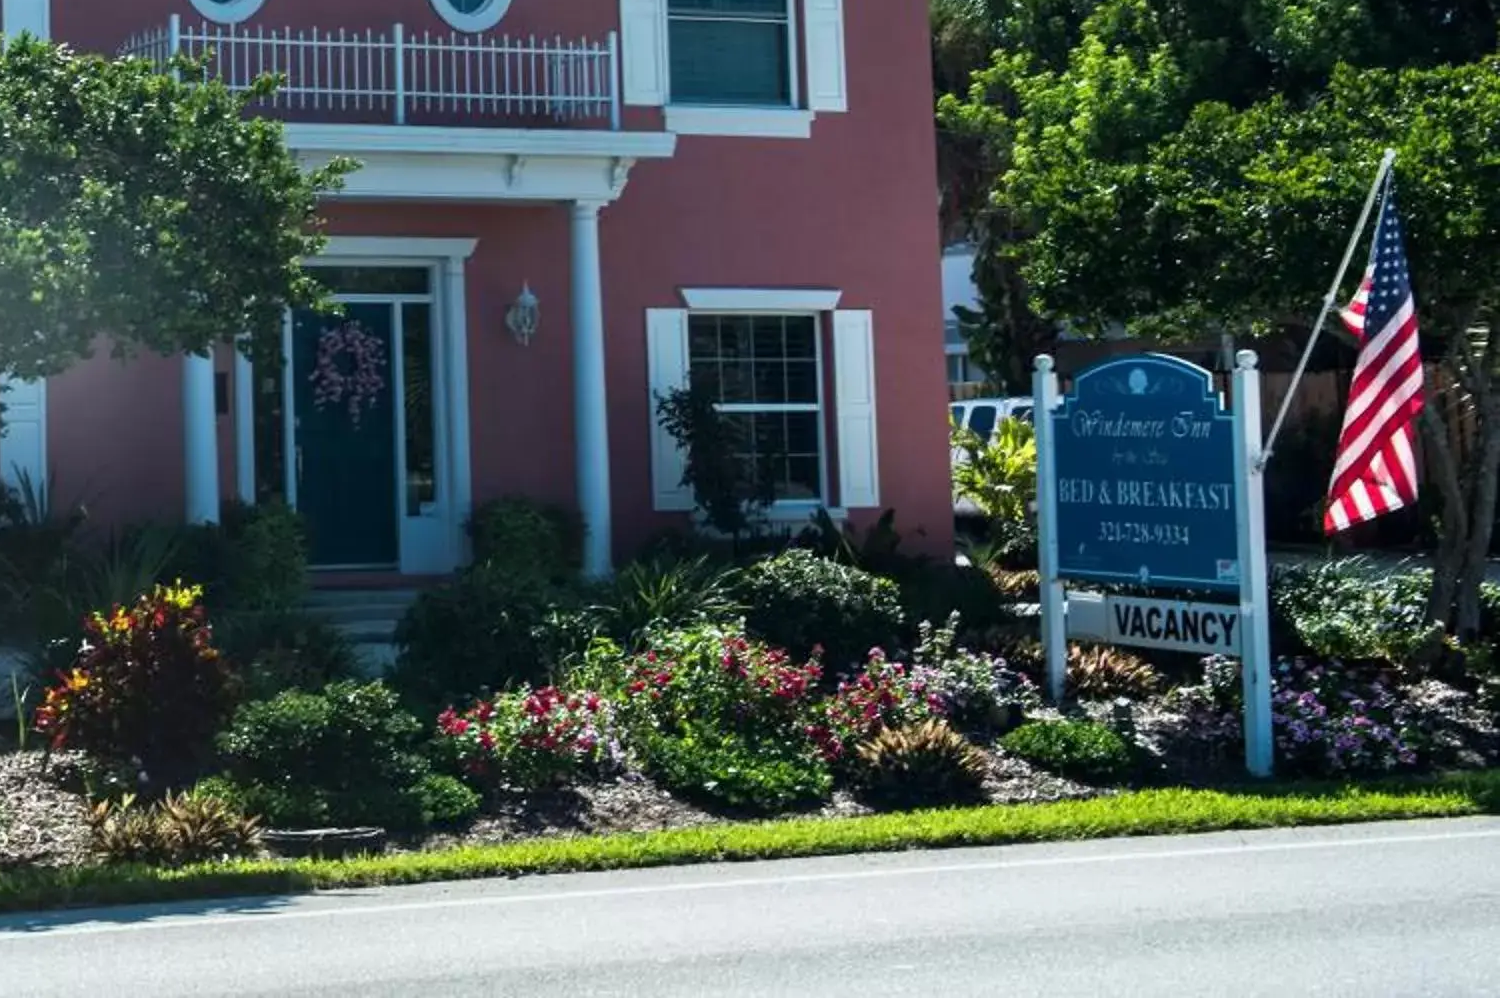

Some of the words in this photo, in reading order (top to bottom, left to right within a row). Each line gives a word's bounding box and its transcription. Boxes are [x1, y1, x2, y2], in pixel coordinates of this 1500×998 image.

[1059, 478, 1093, 503] BED
[1099, 481, 1114, 504] &
[1117, 480, 1233, 511] BREAKFAST
[1114, 603, 1237, 647] VACANCY
